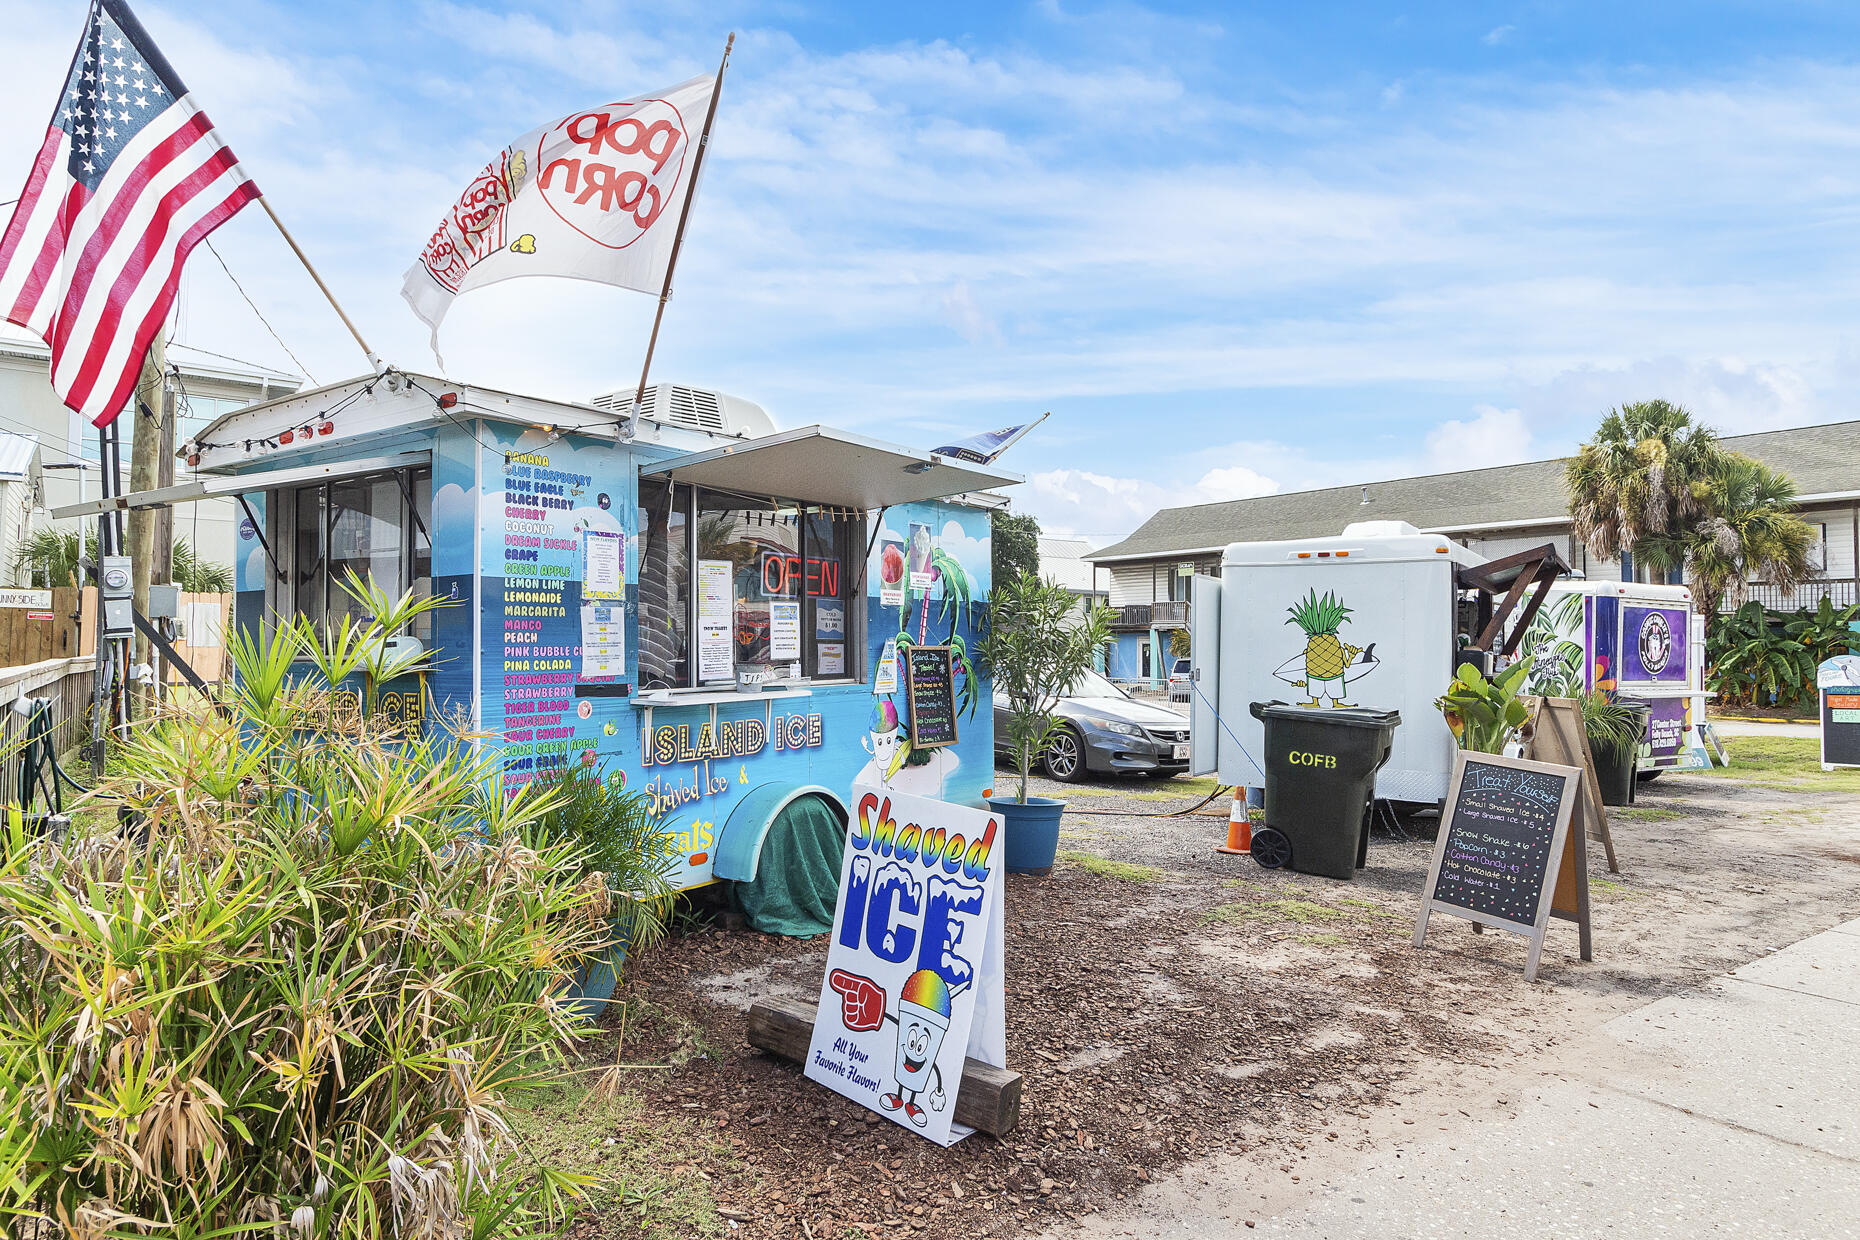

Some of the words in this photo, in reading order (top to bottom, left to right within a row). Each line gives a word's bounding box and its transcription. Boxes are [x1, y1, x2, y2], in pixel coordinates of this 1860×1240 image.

[534, 468, 592, 487] RASPBERRY
[505, 478, 531, 492] BLUE
[534, 482, 564, 496] EAGLE
[505, 492, 539, 506] BLACK
[542, 497, 574, 511] BERRY
[505, 506, 546, 521] CHERRY
[505, 520, 554, 535] COCONUT
[505, 534, 540, 548] DREAM
[543, 538, 577, 551] SICKLE
[505, 548, 538, 562] GRAPE
[504, 563, 537, 575] GREEN
[540, 565, 570, 577] APPLE
[764, 556, 838, 596] OPEN
[504, 577, 539, 589] LEMON
[542, 579, 565, 590] LIME
[504, 591, 562, 604] LEMONAIDE
[504, 605, 566, 617] MARGARITA
[504, 619, 542, 630] MANGO
[504, 632, 537, 643] PEACH
[504, 646, 530, 657] PINK
[533, 646, 570, 657] BUBBLE
[504, 660, 530, 671] PINA
[533, 659, 571, 670] COLADA
[504, 673, 573, 686] STRAWBERRY
[504, 687, 573, 700] STRAWBERRY
[504, 703, 535, 714] TIGER
[538, 700, 569, 712] BLOOD
[504, 714, 561, 728] TANGERINE
[504, 730, 533, 743] SOUR
[536, 726, 575, 740] CHERRY
[641, 719, 766, 767] ISLAND
[775, 713, 821, 751] ICE
[504, 744, 533, 757] SOUR
[536, 740, 567, 753] GREEN
[570, 737, 598, 750] APPLE
[504, 758, 532, 771] SOUR
[1289, 750, 1337, 769] COFB
[504, 772, 532, 786] SOUR
[1467, 768, 1511, 788] Treat
[645, 765, 701, 820] Shaved
[704, 759, 729, 795] Ice
[738, 764, 749, 784] &
[1465, 798, 1486, 808] Small
[1489, 803, 1514, 814] Shaved
[1463, 808, 1480, 819] Large
[1481, 811, 1505, 821] Shaved
[852, 792, 998, 882] Shaved
[1447, 859, 1460, 869] Hot
[1450, 849, 1479, 862] Cotton
[1480, 856, 1506, 873] Candy
[1444, 870, 1460, 880] Cold
[1464, 876, 1485, 887] Water
[839, 854, 985, 990] ICE
[832, 1037, 848, 1054] All
[849, 1042, 868, 1063] Your
[815, 1050, 845, 1077] Favorite
[847, 1065, 881, 1093] Flavors!
